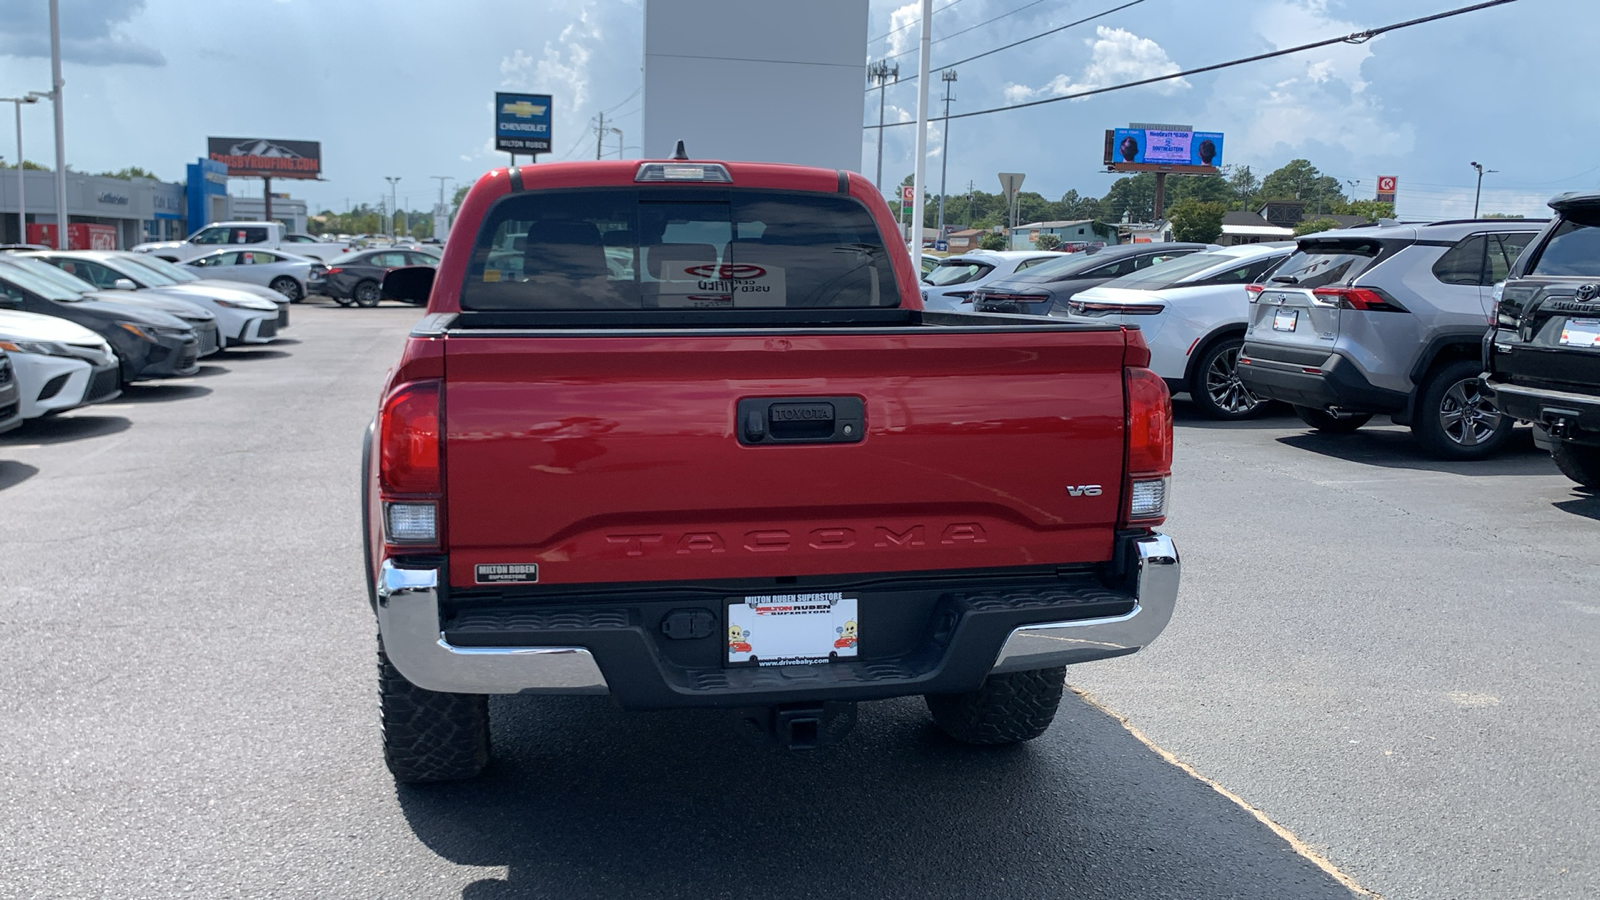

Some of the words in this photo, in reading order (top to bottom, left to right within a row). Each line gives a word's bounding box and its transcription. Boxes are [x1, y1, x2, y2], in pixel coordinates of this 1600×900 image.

[499, 122, 547, 132] CHEVROLET
[499, 139, 524, 147] MILTON
[525, 141, 548, 149] RUBEN
[774, 408, 831, 420] TOYOTA
[1066, 484, 1103, 497] V6
[605, 522, 989, 555] TACOMA
[478, 565, 508, 575] MILTON
[508, 565, 535, 574] RUBEN
[744, 595, 771, 604] MILTON
[772, 594, 796, 603] RUBEN
[797, 592, 843, 603] SUPERSTORE
[758, 657, 830, 668] www.drivebaby.com
